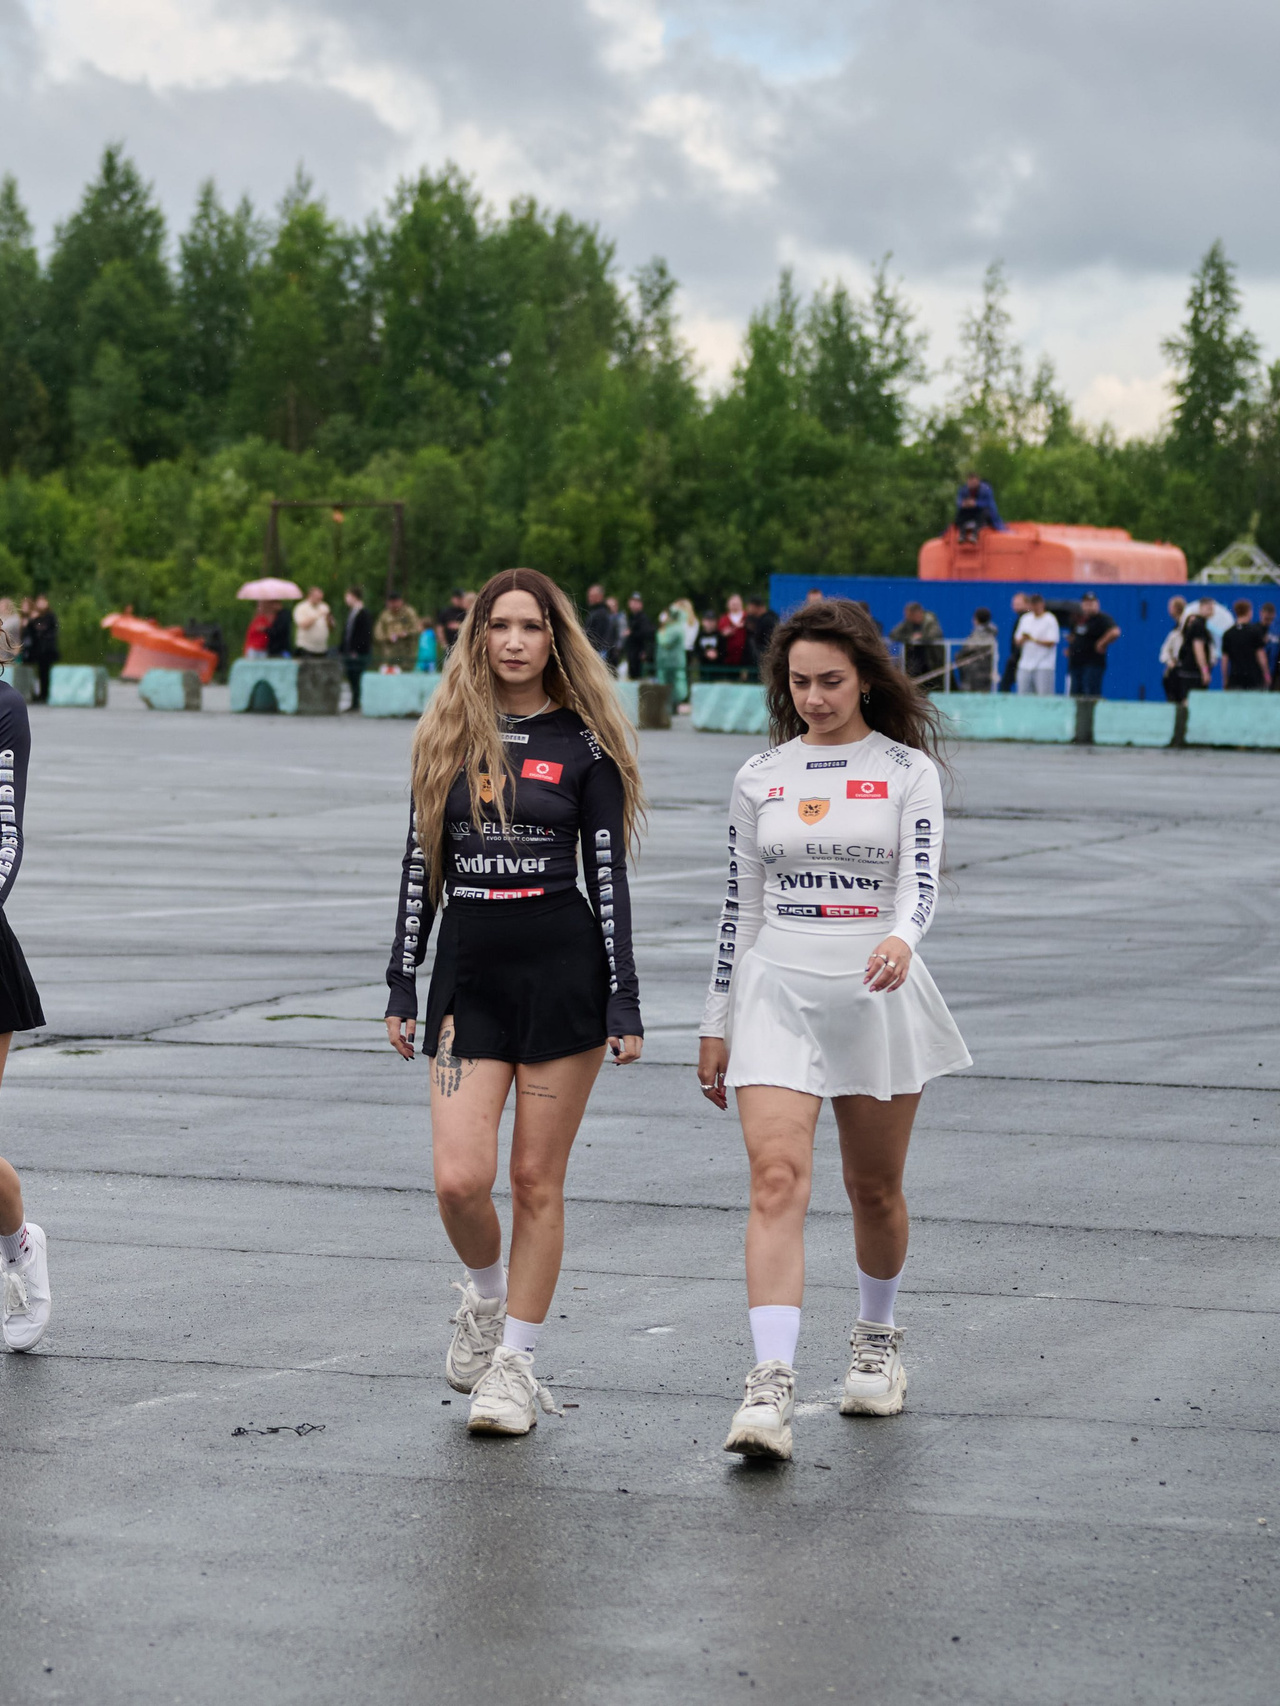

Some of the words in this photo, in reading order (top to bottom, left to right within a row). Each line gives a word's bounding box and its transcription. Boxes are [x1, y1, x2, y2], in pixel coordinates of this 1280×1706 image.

[768, 786, 785, 797] E1
[483, 822, 556, 837] ELECTRA
[806, 843, 894, 859] ELECTRA
